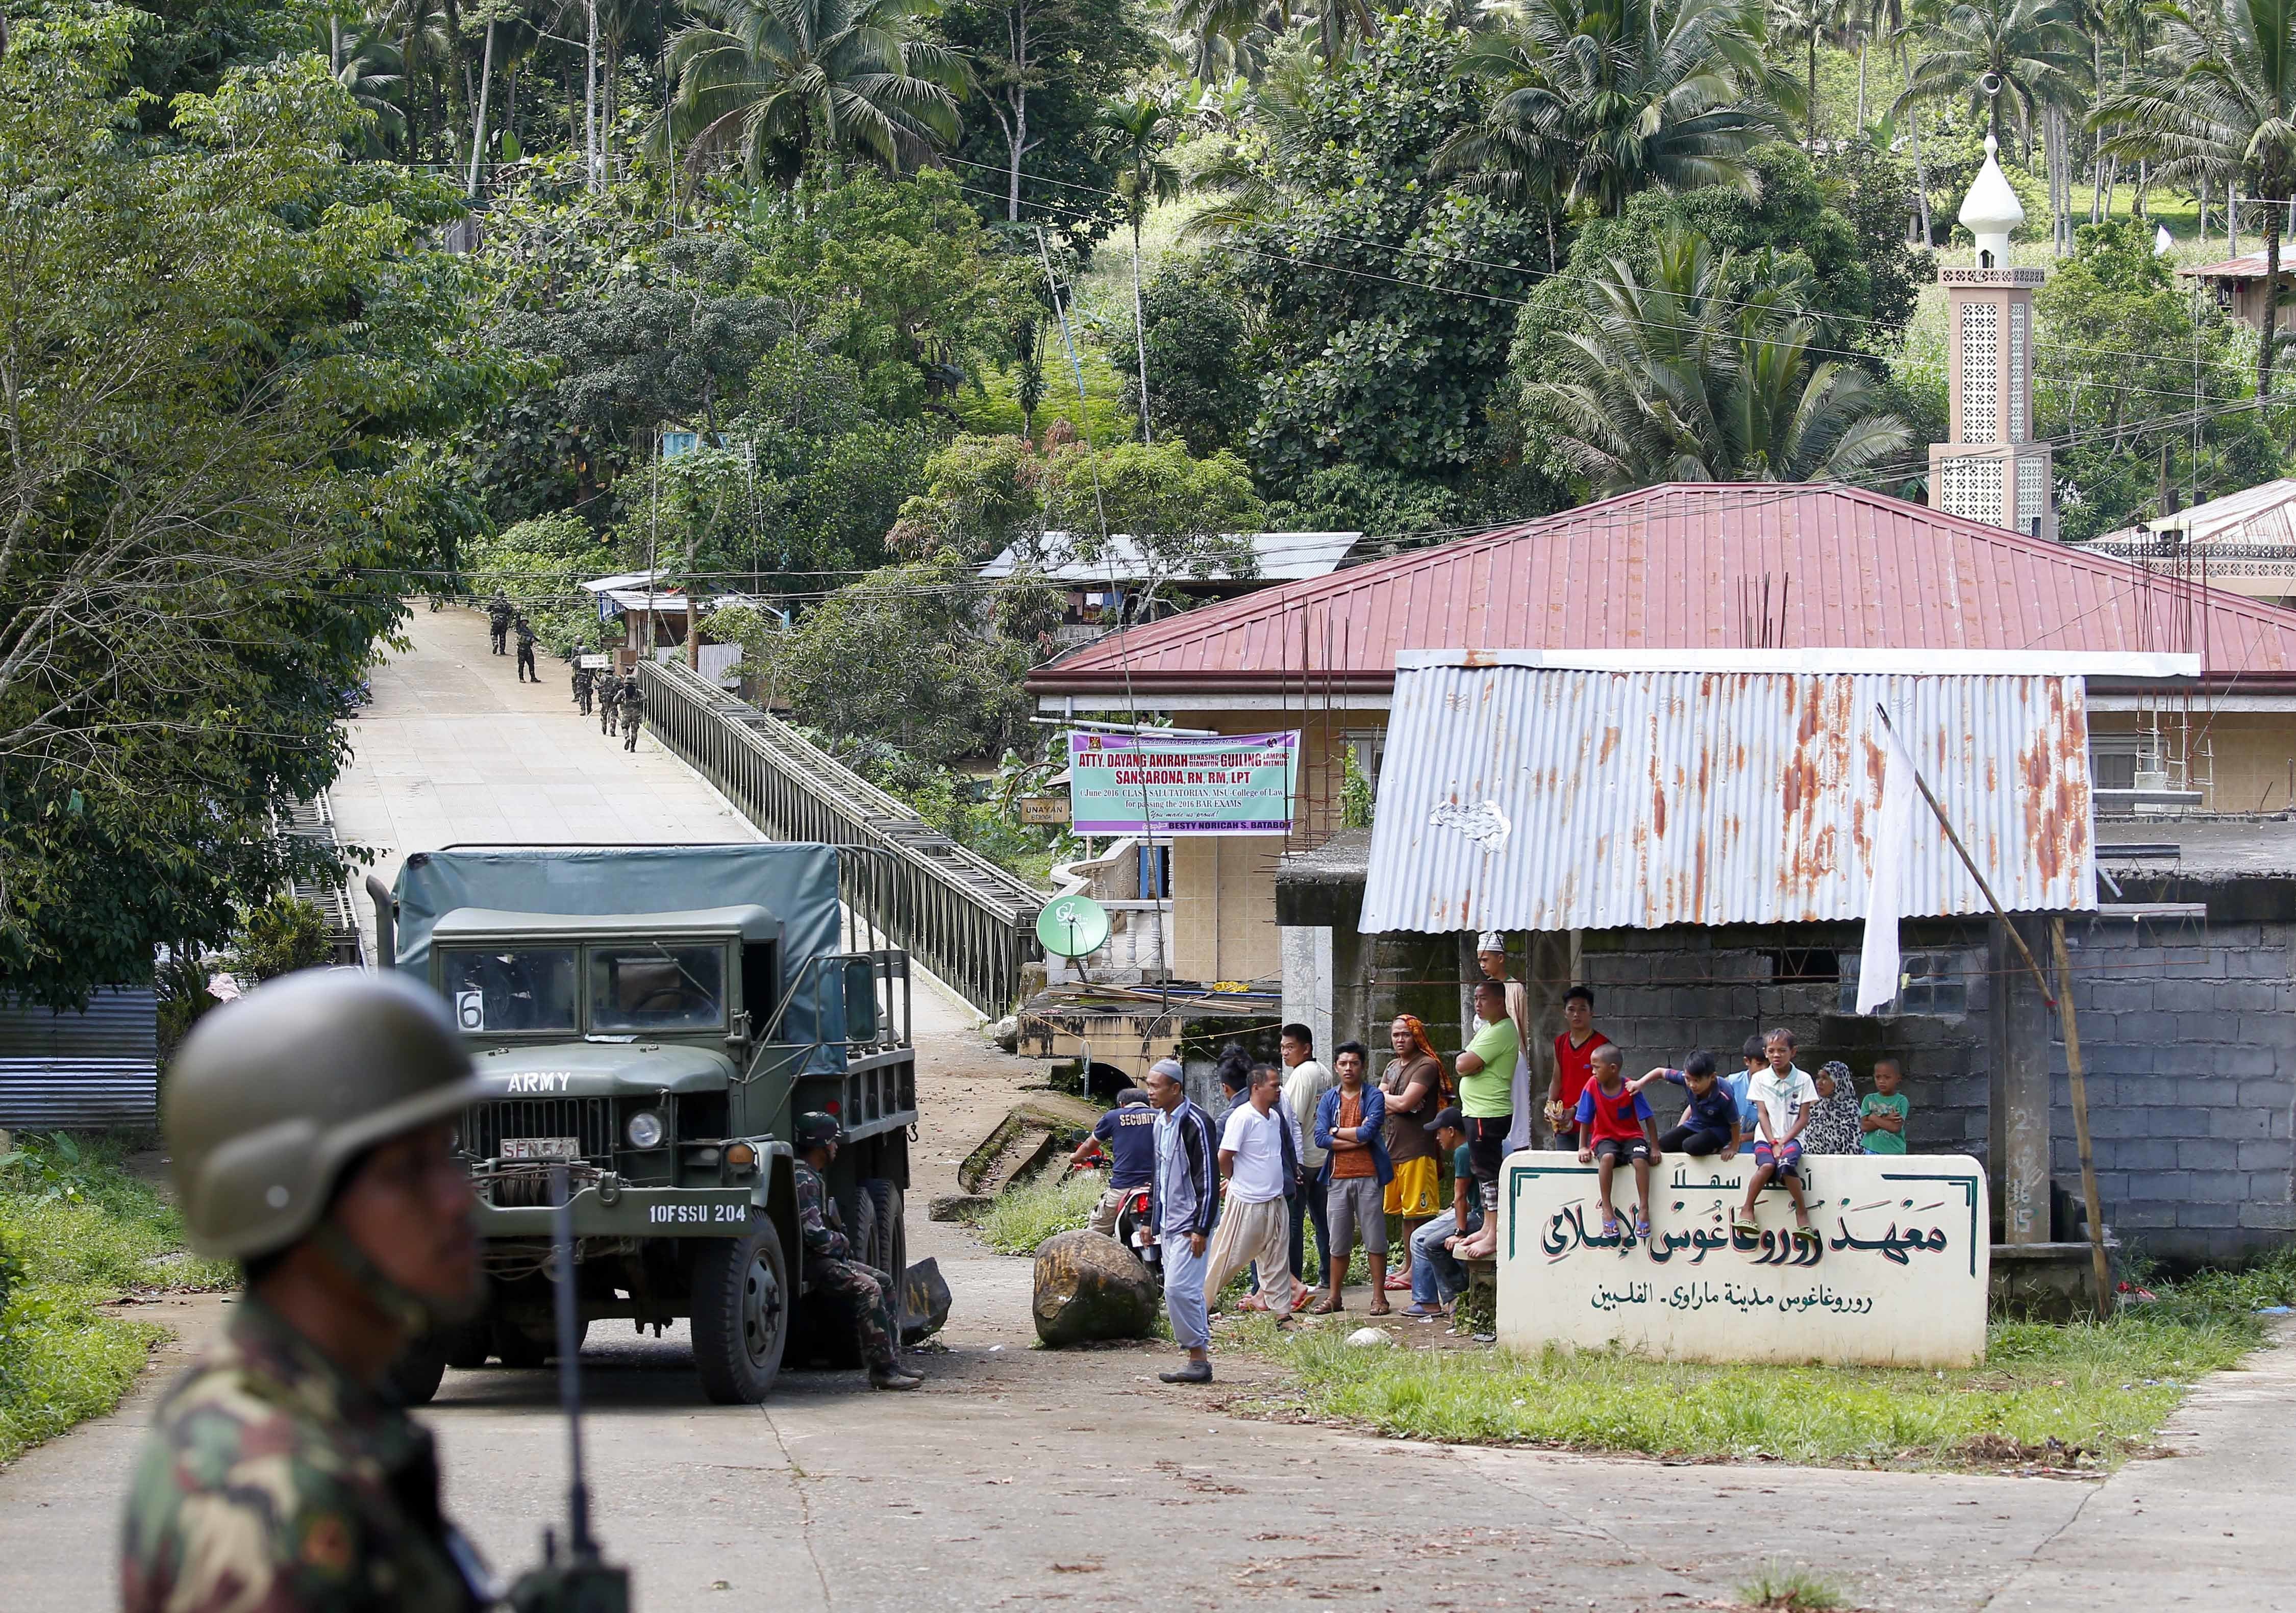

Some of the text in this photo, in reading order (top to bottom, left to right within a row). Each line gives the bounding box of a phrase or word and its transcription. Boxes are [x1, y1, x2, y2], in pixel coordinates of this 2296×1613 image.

[1079, 753, 1105, 767] ATTY.
[1108, 753, 1146, 767] DAYANG
[1149, 754, 1188, 767] AKIRAH
[1220, 753, 1262, 767] GUILING
[1116, 770, 1251, 785] SANSARONA, RN, RM, LPT
[1149, 789, 1211, 798] SALUTATORIAN,
[1212, 789, 1258, 798] MSU-College
[1137, 800, 1164, 810] passing
[1214, 799, 1242, 808] EXAMS
[1150, 810, 1163, 819] You
[1195, 810, 1220, 819] proud!
[459, 993, 482, 1028] 6
[507, 1072, 571, 1092] ARMY
[1119, 1113, 1156, 1126] SECURIT
[1420, 1192, 1428, 1208] 3
[650, 1204, 746, 1223] 10FSSU 204
